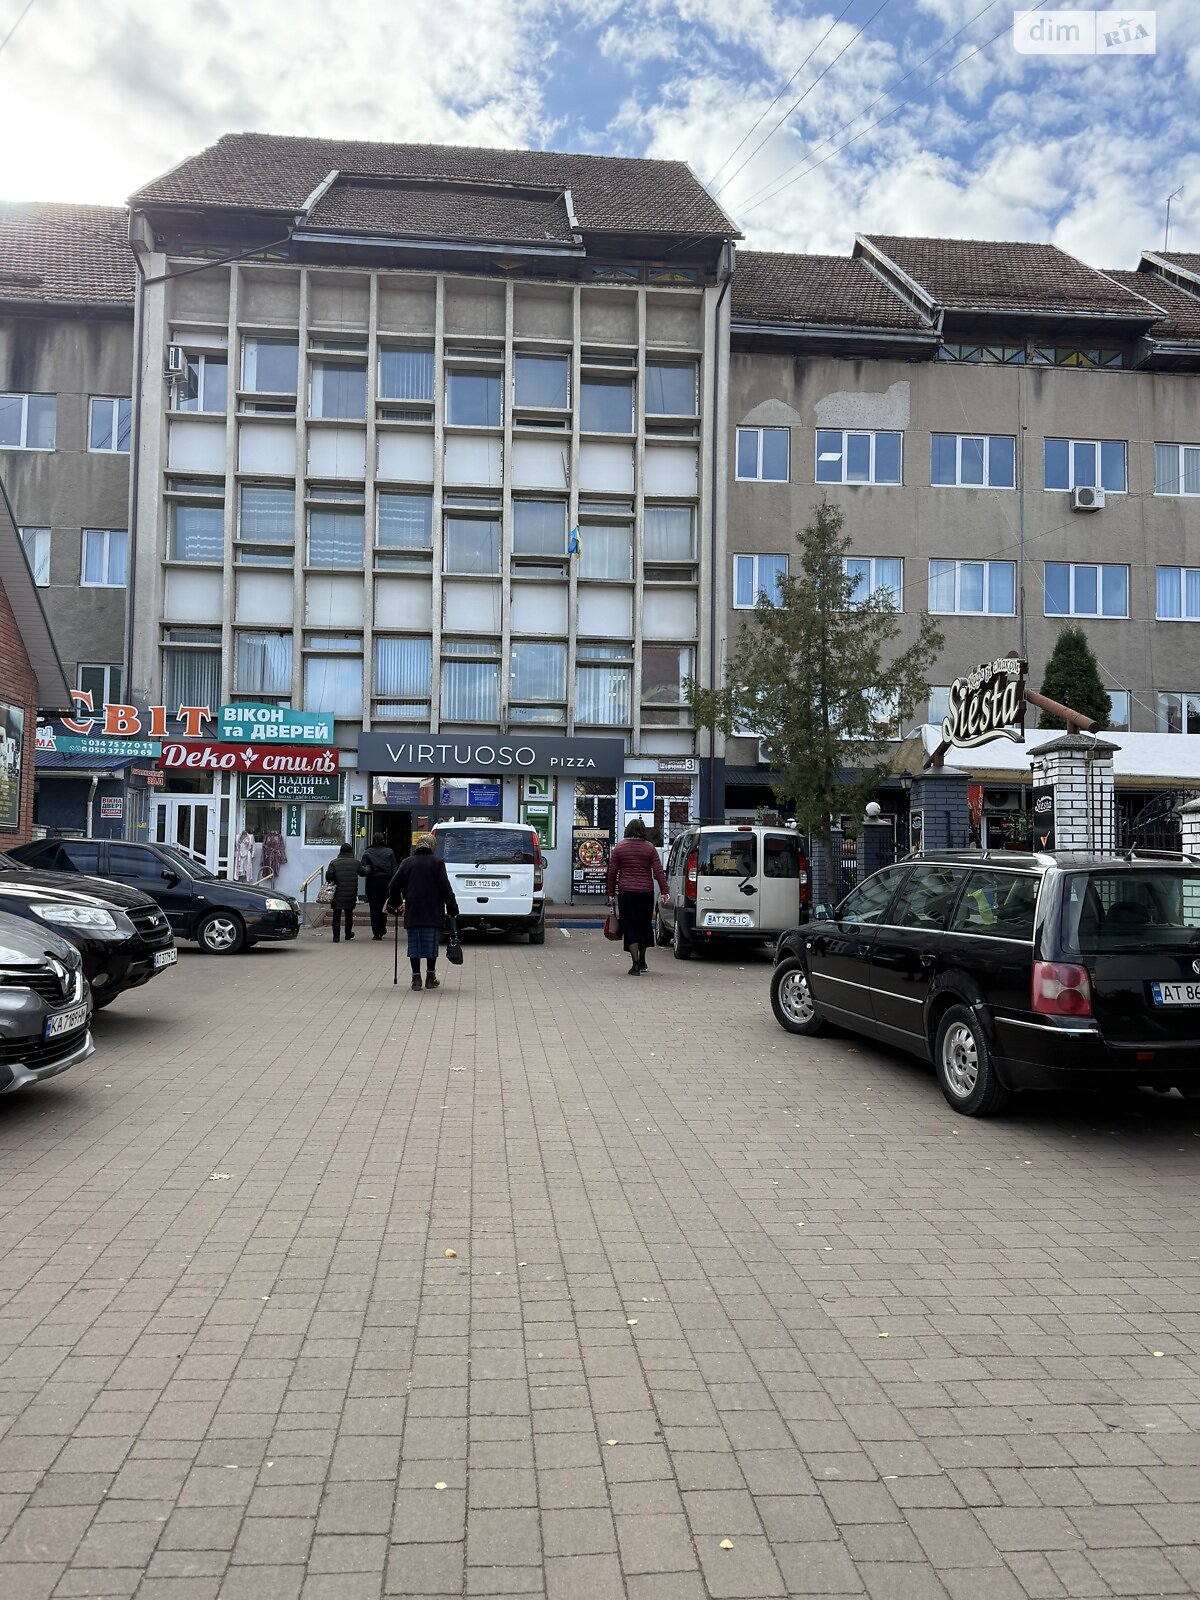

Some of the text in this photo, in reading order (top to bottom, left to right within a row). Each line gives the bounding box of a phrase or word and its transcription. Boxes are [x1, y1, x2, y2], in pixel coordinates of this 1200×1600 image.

[224, 708, 284, 722] ВІКОН
[942, 677, 1020, 744] Siesta
[223, 722, 329, 740] та ДВЕРЕЙ
[88, 746, 106, 754] 050
[107, 747, 125, 755] 373
[386, 743, 596, 768] VIRTUOSO PIZZA
[262, 752, 336, 773] стиль
[686, 759, 694, 769] 3
[278, 774, 331, 786] НАДІЙНА
[278, 785, 315, 795] ОСЕЛЯ
[632, 784, 649, 808] P
[1164, 985, 1182, 1001] AT
[51, 1016, 63, 1033] KA
